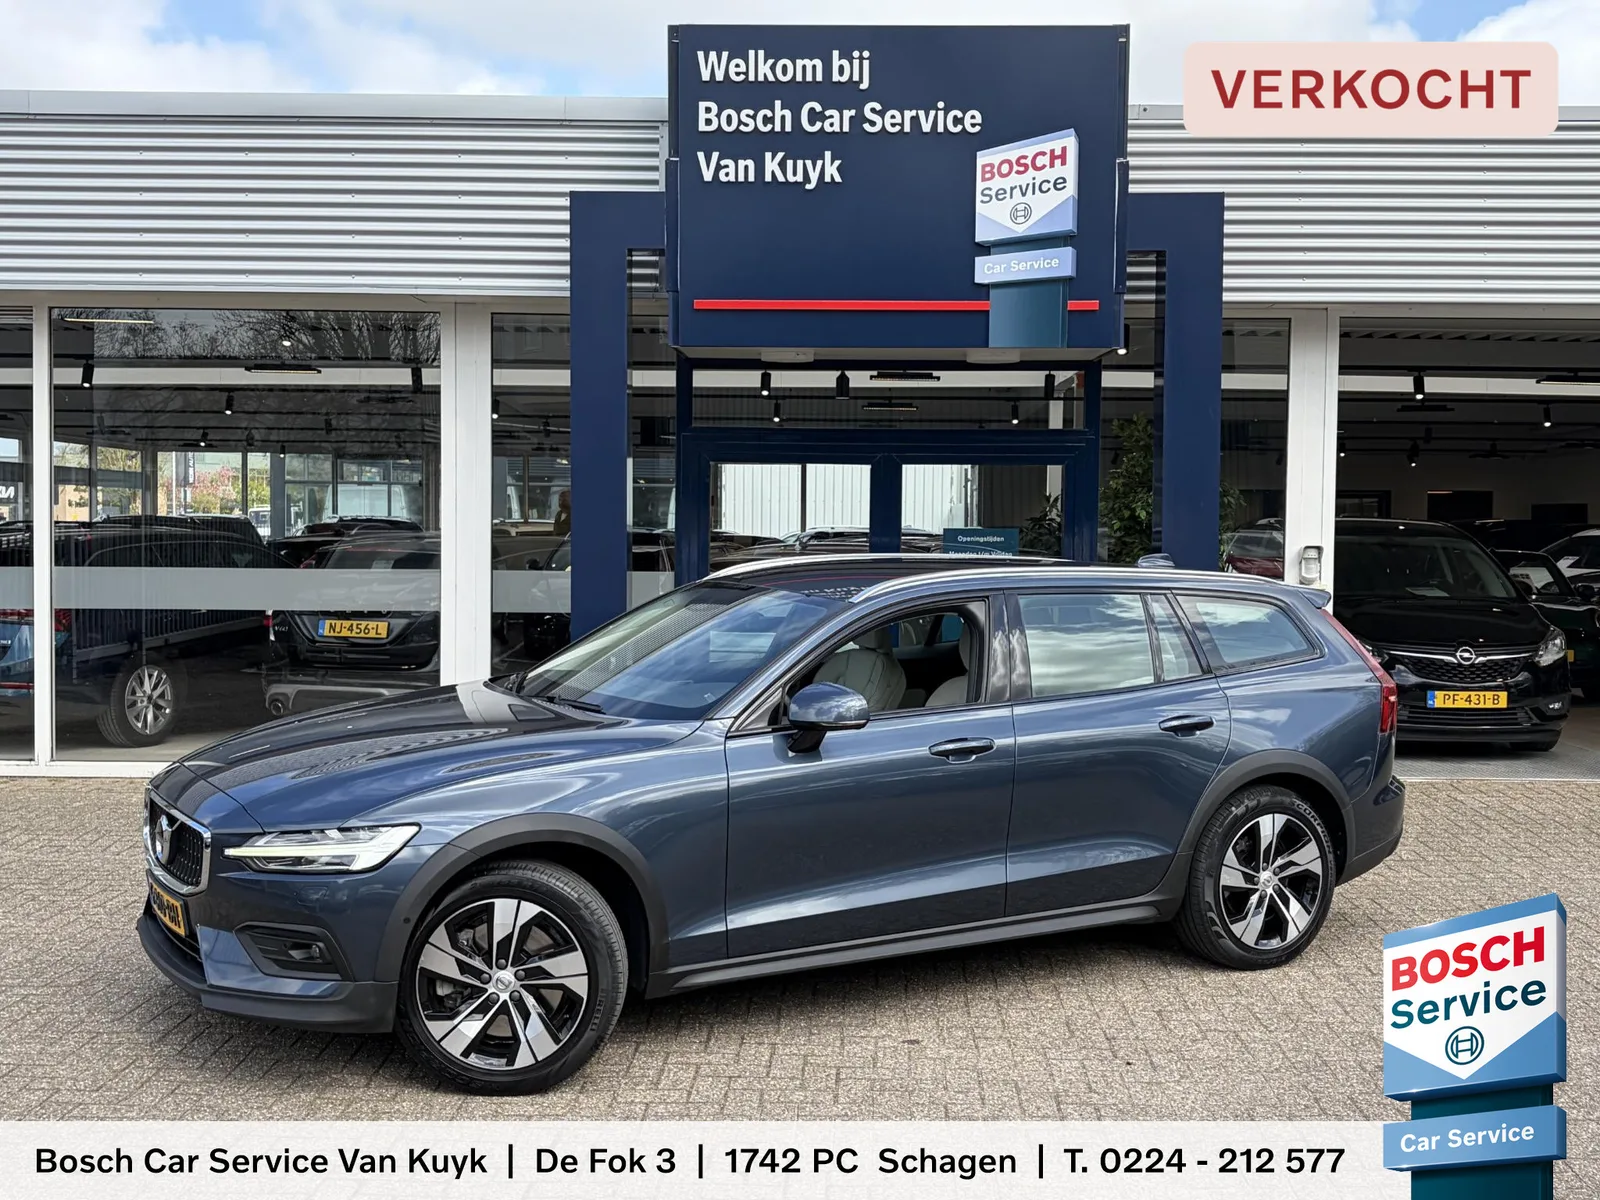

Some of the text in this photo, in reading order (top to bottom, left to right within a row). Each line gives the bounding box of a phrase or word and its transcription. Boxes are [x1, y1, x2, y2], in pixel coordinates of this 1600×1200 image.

[697, 50, 871, 89] Welkom bij
[698, 101, 982, 133] Bosch Car Service
[697, 151, 843, 189] Van Kuyk
[981, 146, 1067, 182] BOSCH
[980, 176, 1067, 204] Service
[984, 257, 1059, 274] Car Service
[957, 535, 1005, 543] Openingstijden
[328, 622, 382, 635] NJ-456-L
[1443, 693, 1501, 706] PF-431-B
